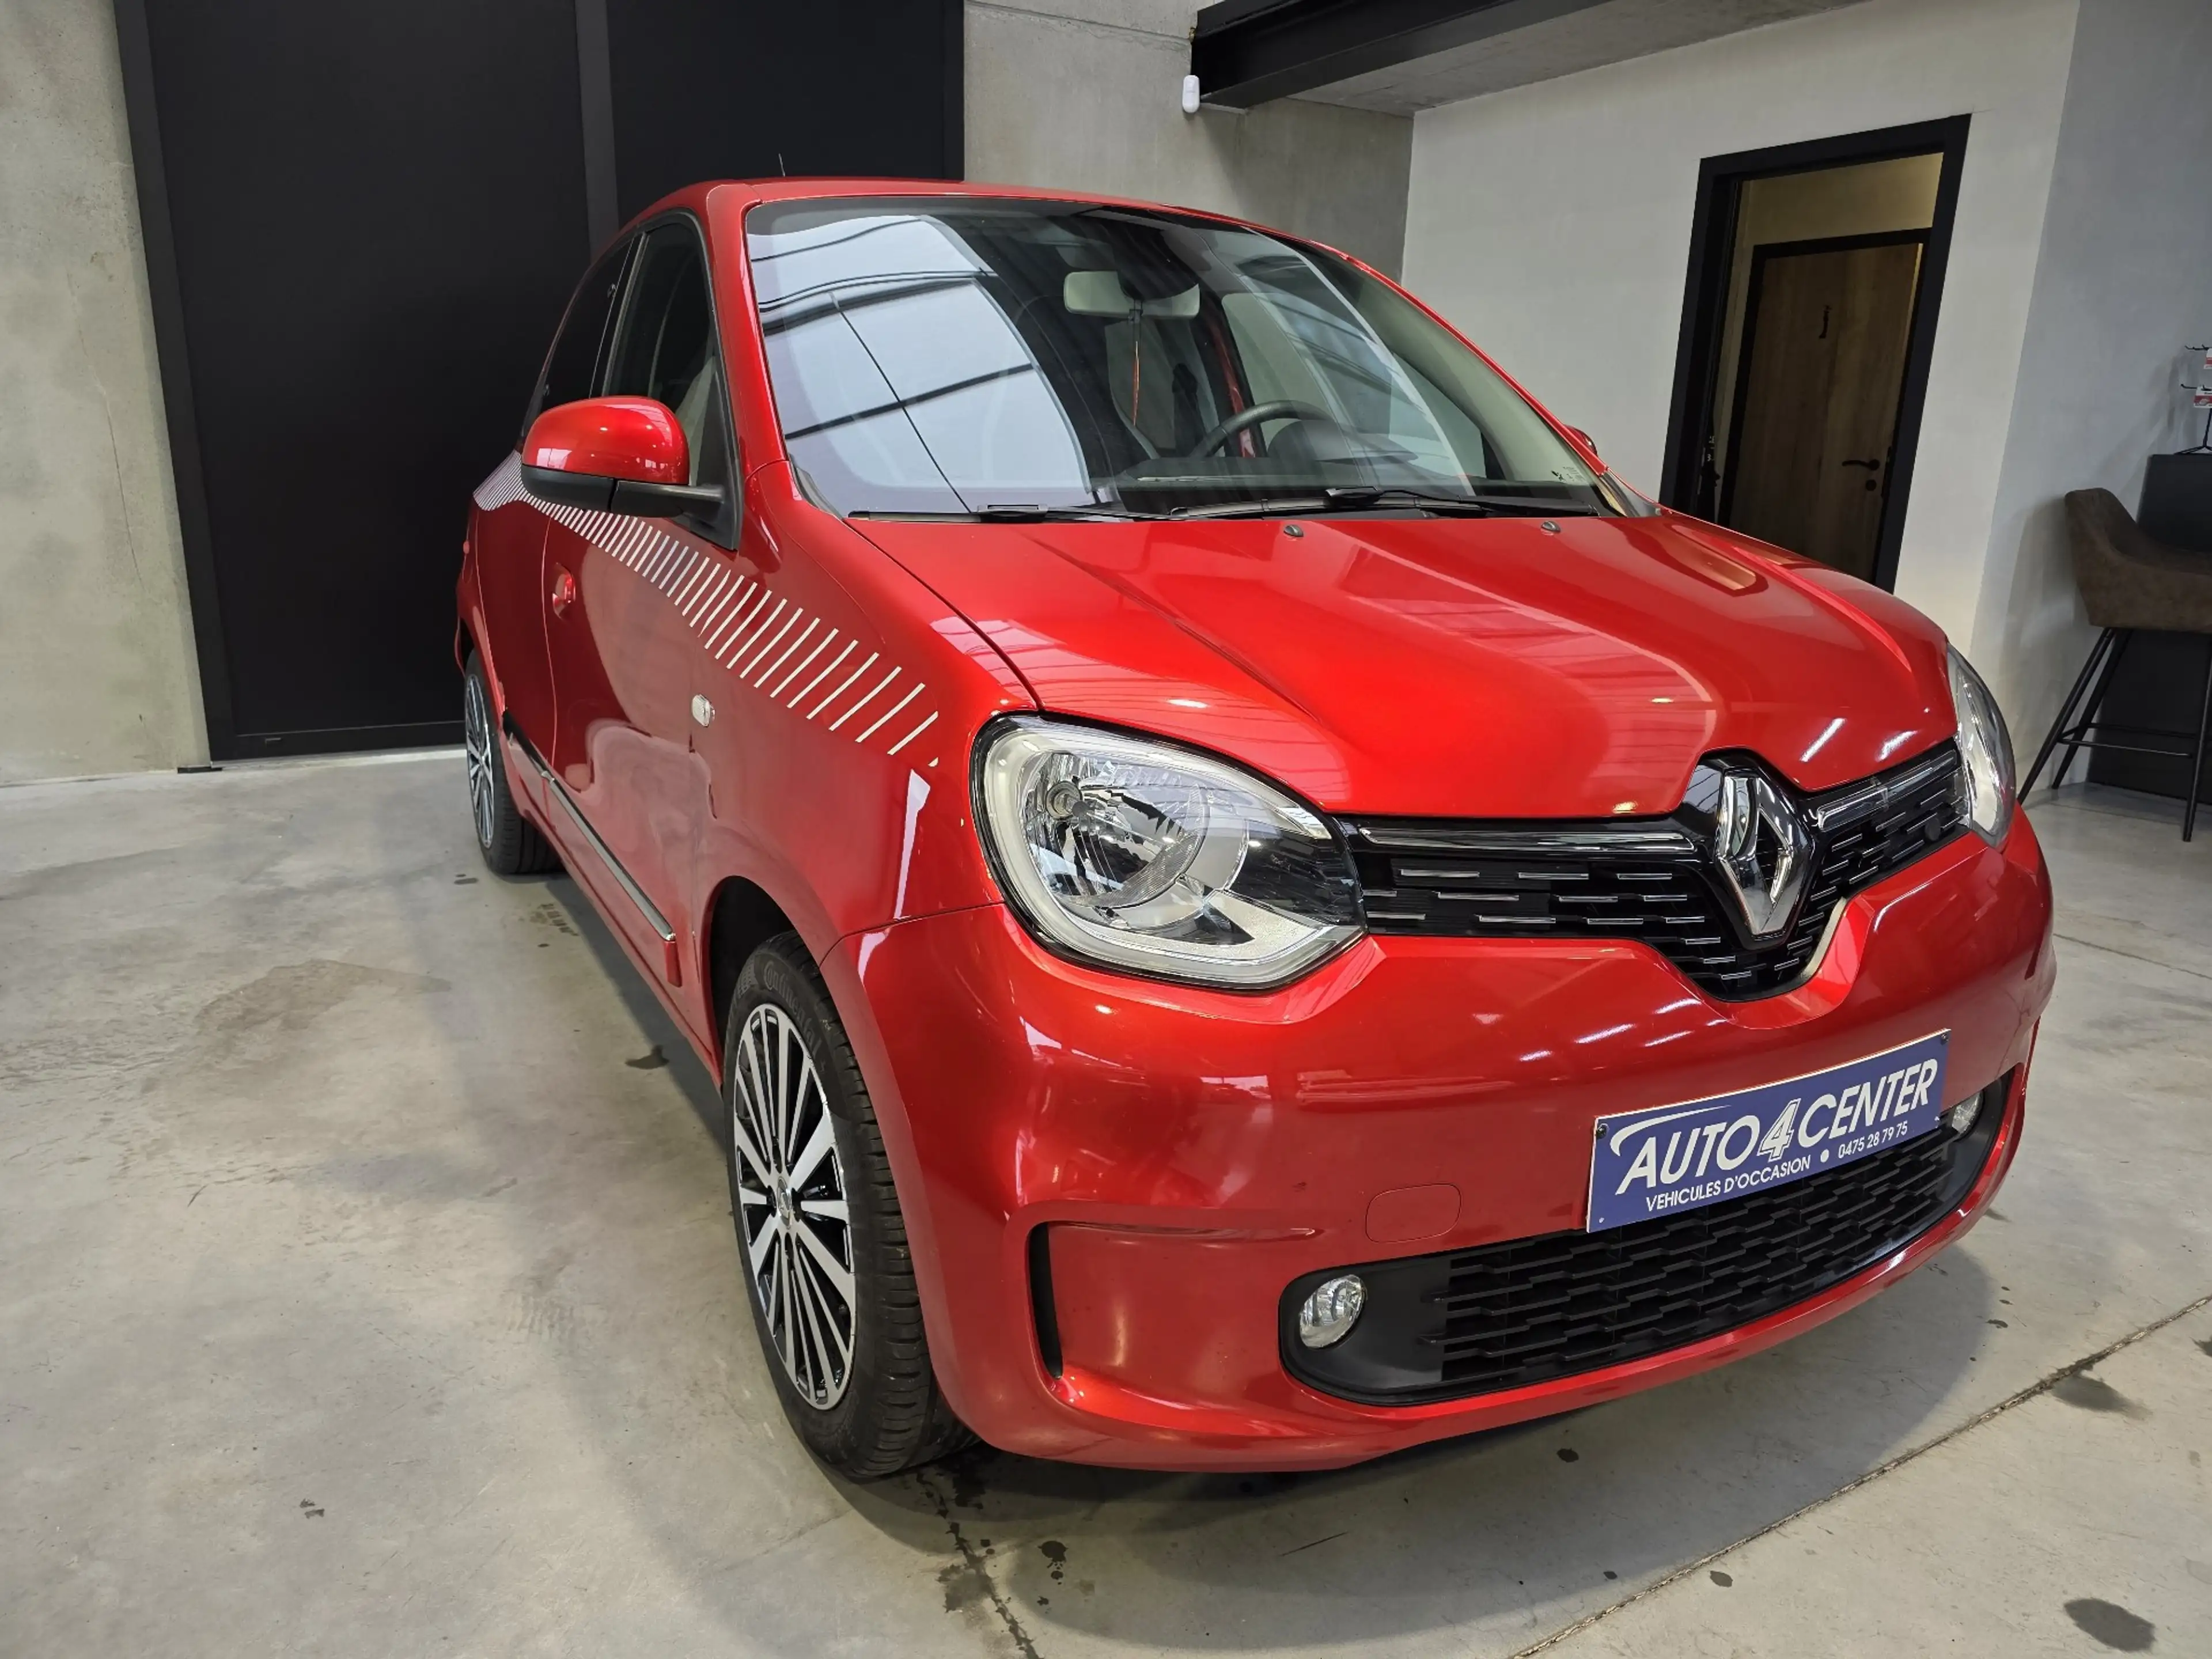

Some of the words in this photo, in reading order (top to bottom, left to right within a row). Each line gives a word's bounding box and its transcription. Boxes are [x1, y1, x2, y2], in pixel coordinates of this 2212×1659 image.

[763, 960, 823, 1060] Continental
[1646, 1180, 1721, 1212] VEHICULES
[1724, 1154, 1811, 1194] D'OCCASION
[1838, 1139, 1865, 1159] 0475
[1866, 1131, 1880, 1149] 28
[1881, 1126, 1894, 1143] 79
[1896, 1121, 1908, 1138] 75
